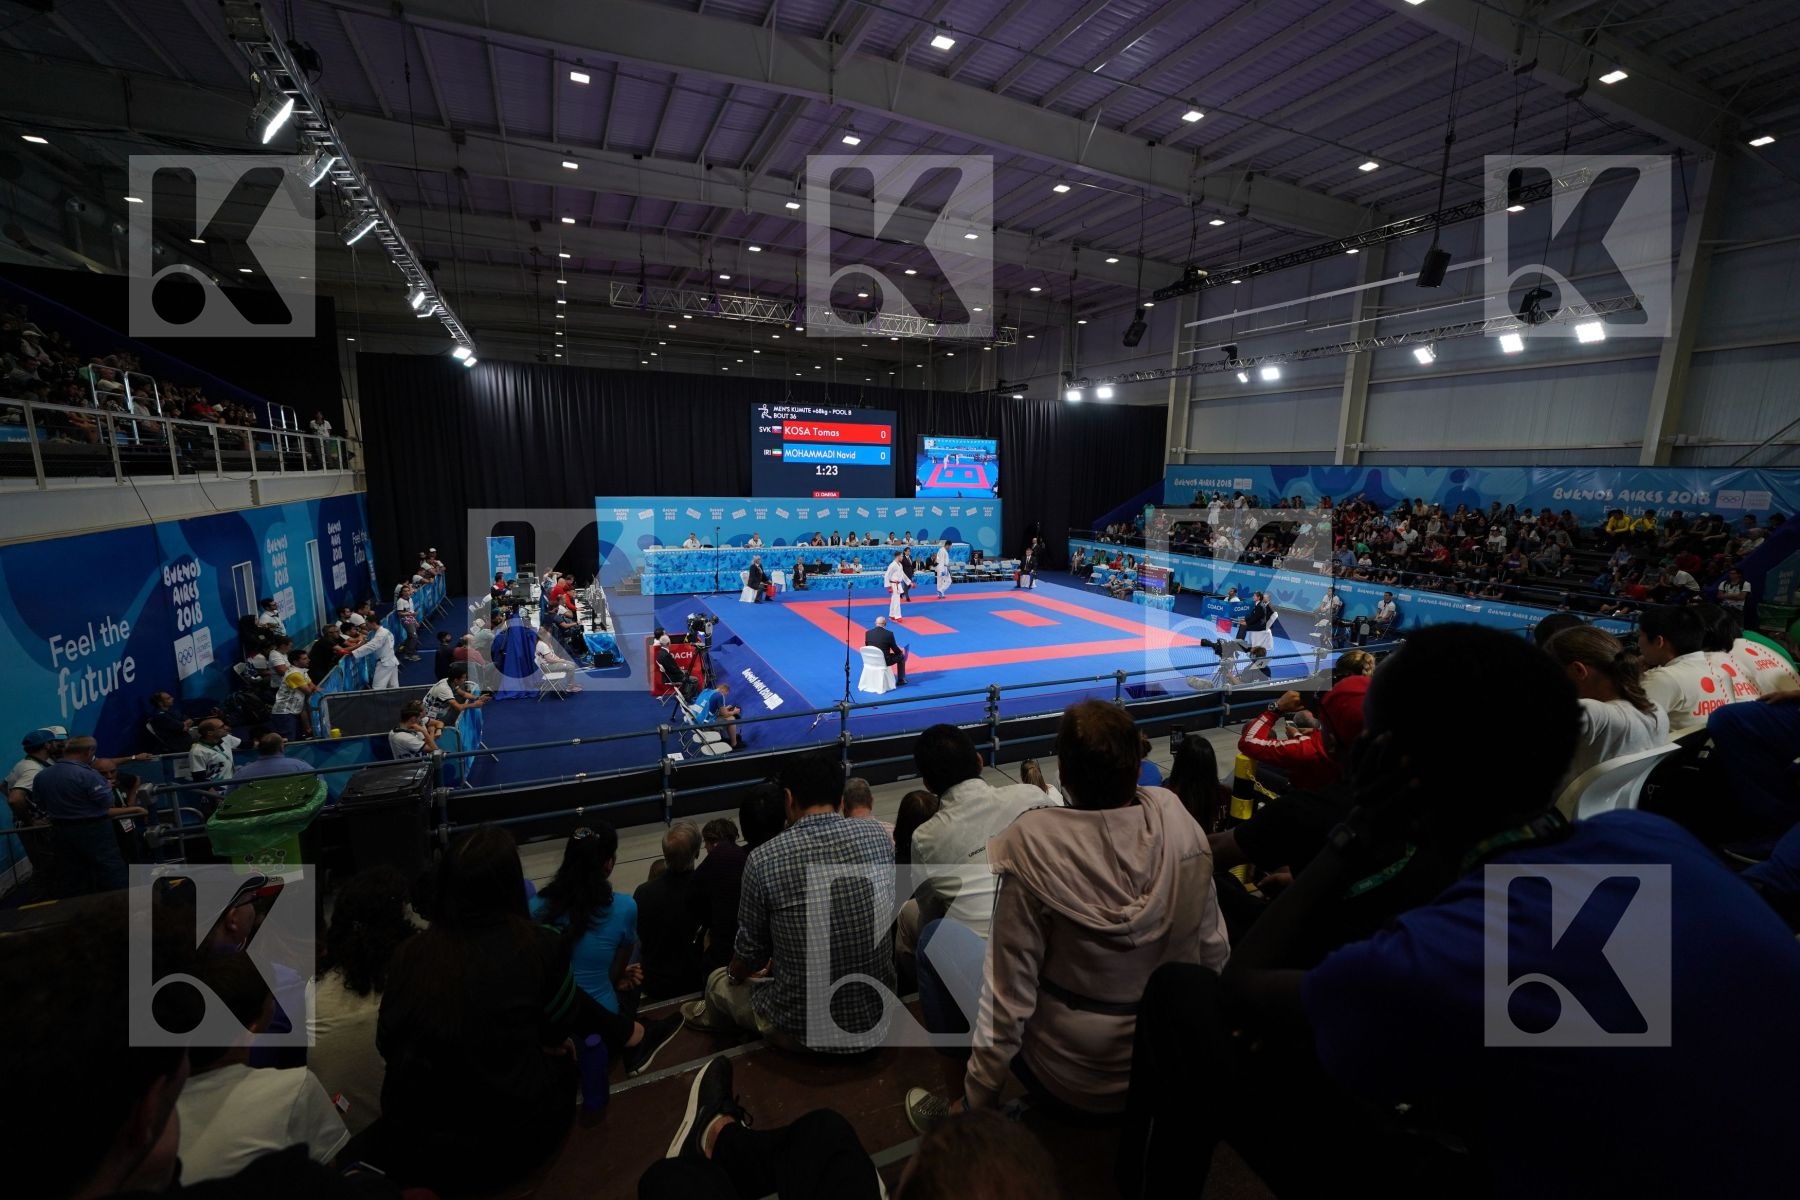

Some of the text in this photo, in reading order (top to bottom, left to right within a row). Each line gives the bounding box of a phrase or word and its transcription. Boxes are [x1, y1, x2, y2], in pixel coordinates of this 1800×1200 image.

[784, 426, 811, 436] KOSA
[813, 427, 840, 437] Tomas
[880, 430, 886, 439] 0
[784, 448, 835, 459] MOHAMMADI
[836, 451, 856, 460] Navid
[880, 452, 886, 460] 0
[815, 464, 838, 475] 1:23
[1552, 487, 1711, 505] BUENOS AIRES 2018
[1656, 506, 1697, 518] futre
[266, 533, 288, 554] BUENOS
[164, 558, 202, 587] BUENOS
[274, 566, 290, 588] 2018
[173, 580, 200, 606] AIRES
[1207, 603, 1224, 611] COACH
[177, 600, 204, 632] 2018
[49, 615, 130, 669] Feel the
[670, 651, 693, 660] ACH
[1755, 659, 1778, 671] JAPAN
[57, 656, 136, 719] future
[1732, 682, 1759, 697] APAN
